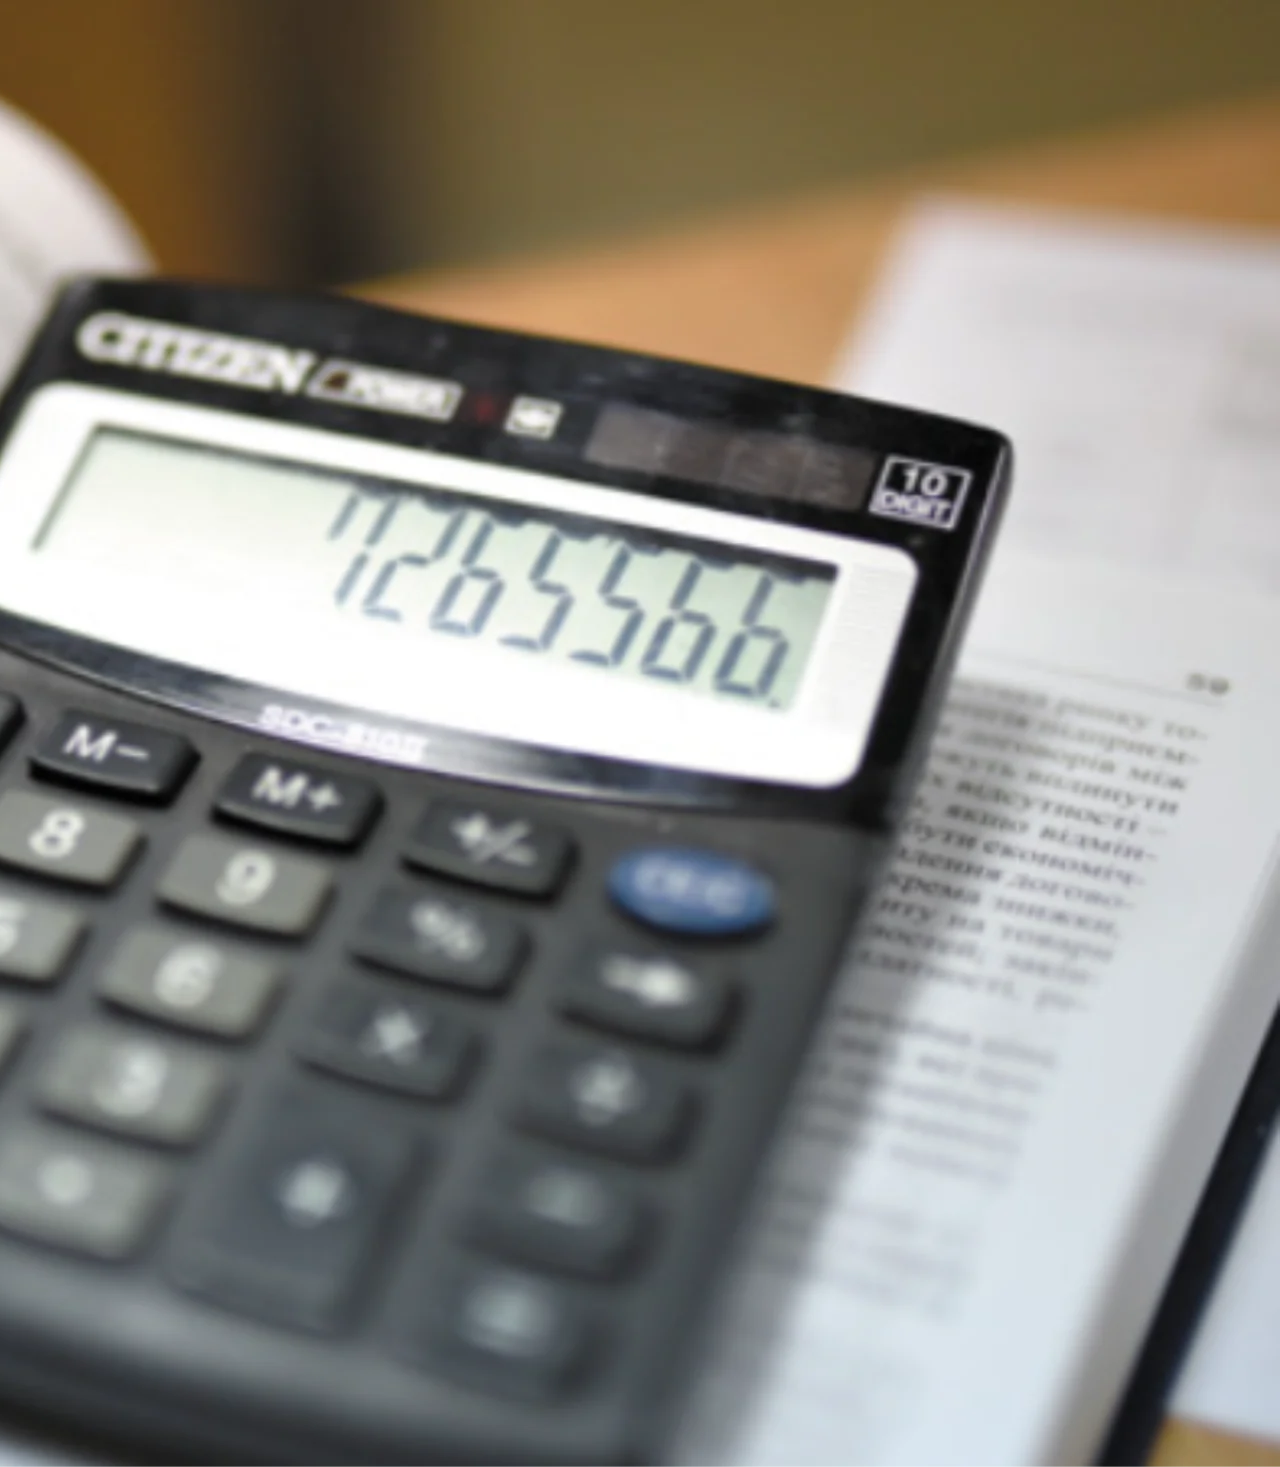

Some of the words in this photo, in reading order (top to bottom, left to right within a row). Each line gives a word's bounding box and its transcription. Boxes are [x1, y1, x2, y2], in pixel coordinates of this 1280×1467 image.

[76, 311, 317, 395] CITIZEN
[879, 490, 954, 524] DIGIT
[900, 466, 948, 496] 10
[28, 808, 85, 860] 8
[217, 846, 276, 906] 9
[152, 941, 220, 1009] 6
[94, 1044, 169, 1119] 3
